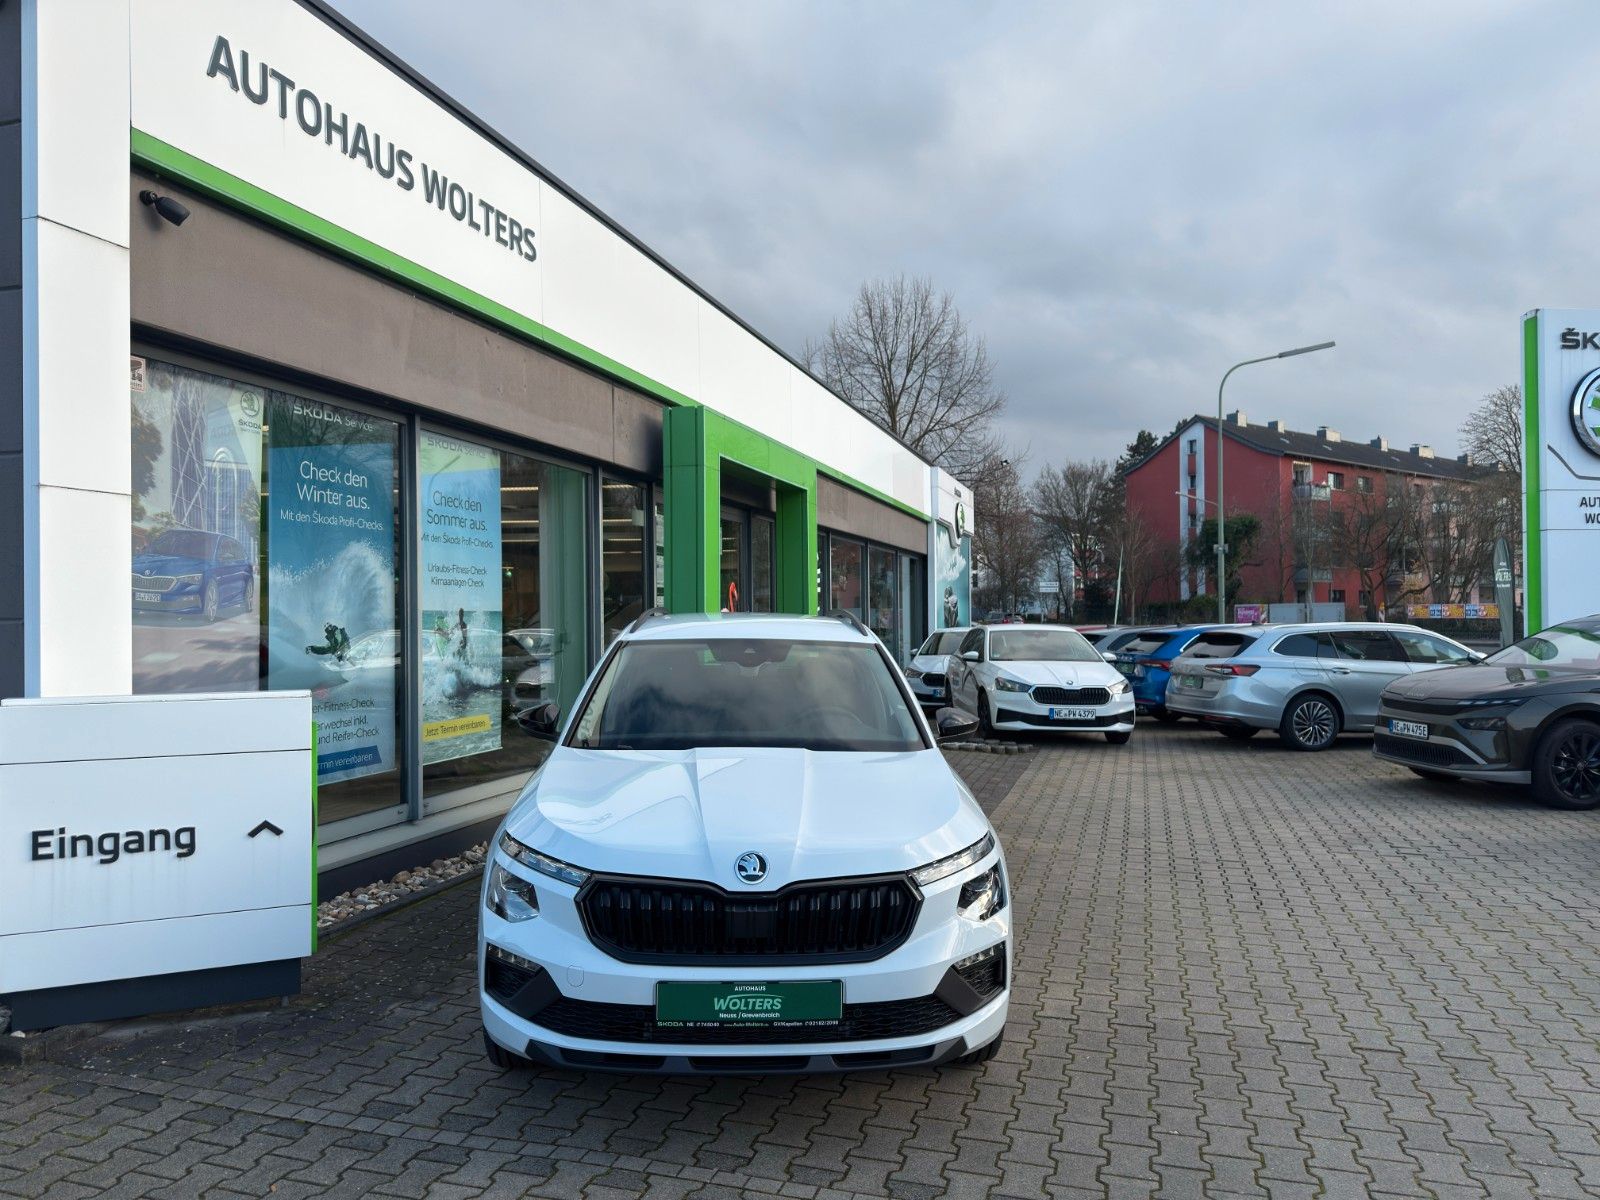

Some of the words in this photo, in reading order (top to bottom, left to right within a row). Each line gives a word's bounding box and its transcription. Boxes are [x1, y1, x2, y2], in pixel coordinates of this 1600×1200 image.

[206, 34, 415, 192] AUTOHAUS
[421, 162, 537, 263] WOLTERS
[300, 460, 342, 484] Check
[343, 469, 368, 489] den
[296, 482, 343, 506] Winter
[345, 494, 371, 510] aus.
[433, 489, 464, 509] Check
[464, 497, 482, 513] den
[280, 508, 295, 521] Mit
[295, 511, 311, 524] den
[312, 510, 338, 526] Škoda
[426, 508, 468, 528] Sommer
[469, 517, 488, 532] aus.
[431, 534, 442, 543] den
[1078, 709, 1095, 718] 4379
[425, 727, 439, 737] Jetzt
[440, 725, 458, 734] Termin
[334, 753, 373, 767] vereinbaren
[31, 827, 196, 864] Eingang
[714, 996, 782, 1011] WOLTERS
